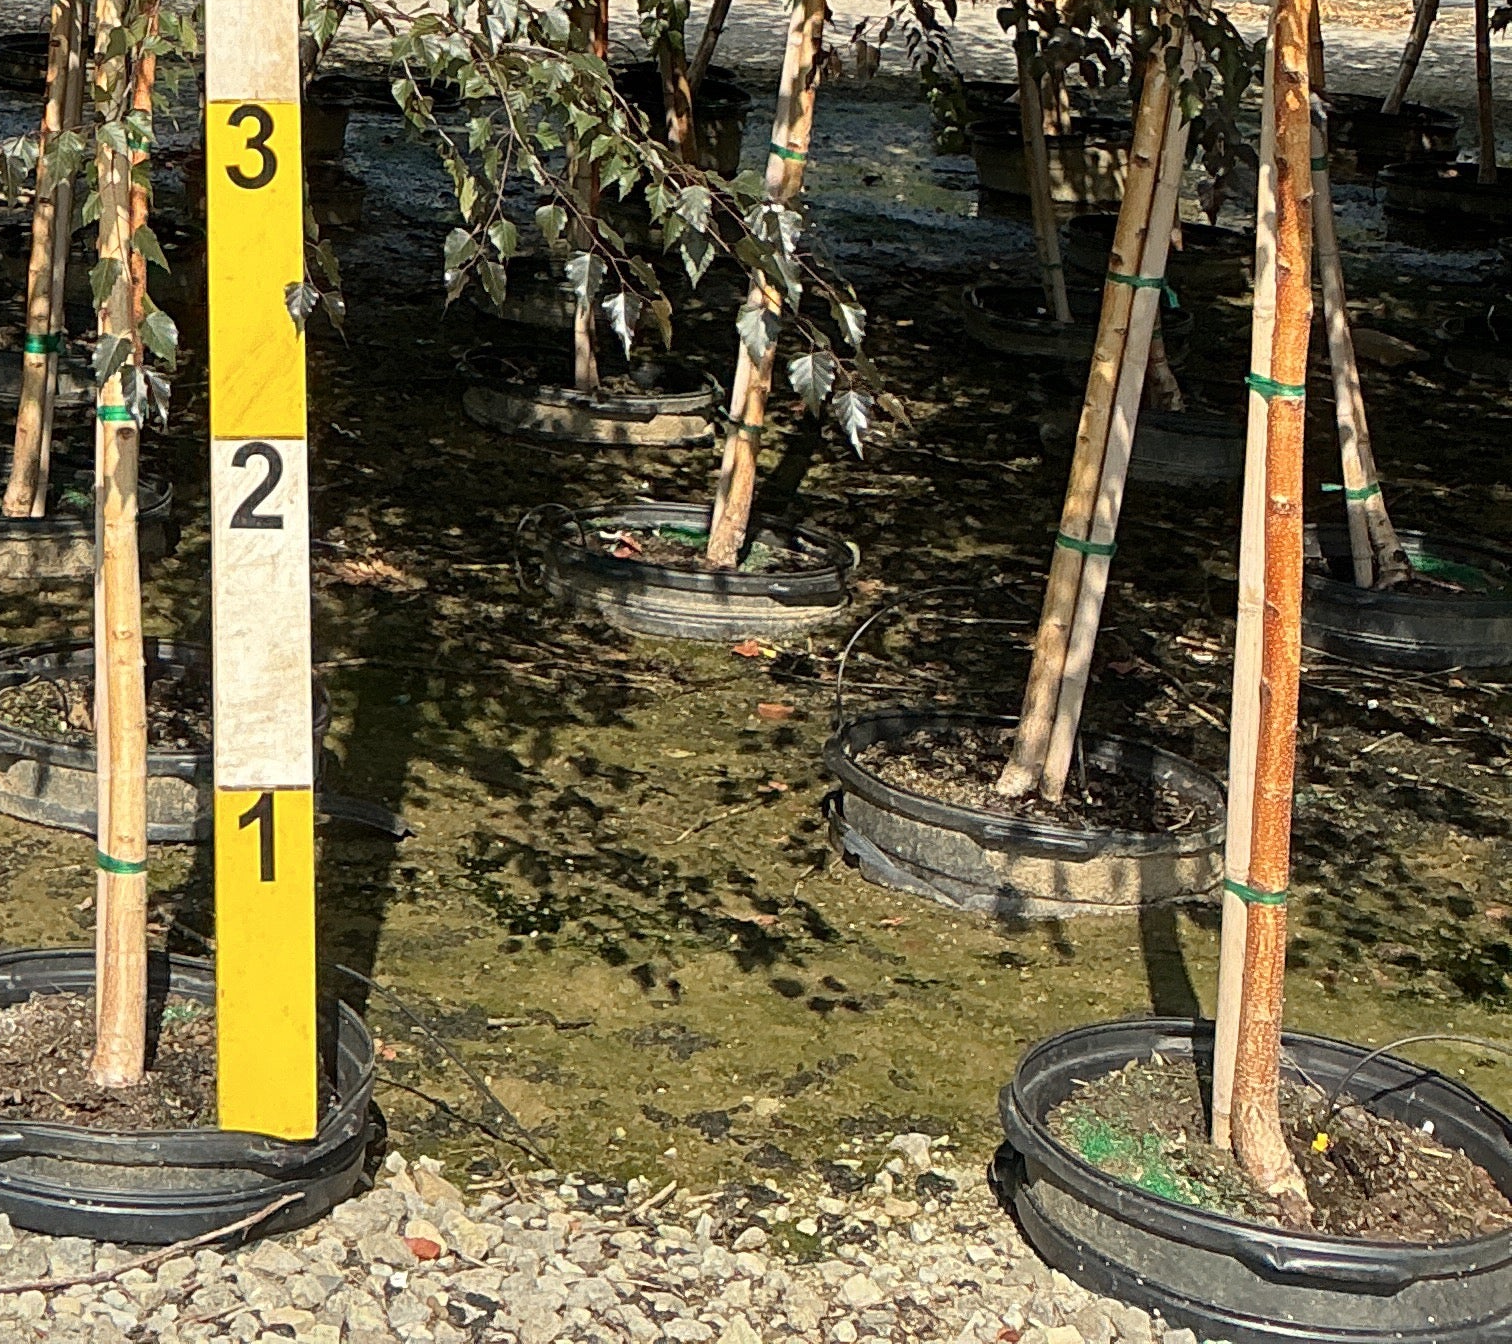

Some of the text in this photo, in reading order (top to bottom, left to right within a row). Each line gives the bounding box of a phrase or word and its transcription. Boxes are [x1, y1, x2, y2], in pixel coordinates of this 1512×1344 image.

[225, 103, 278, 190] 3
[230, 441, 284, 529] 2
[238, 791, 276, 882] 1
